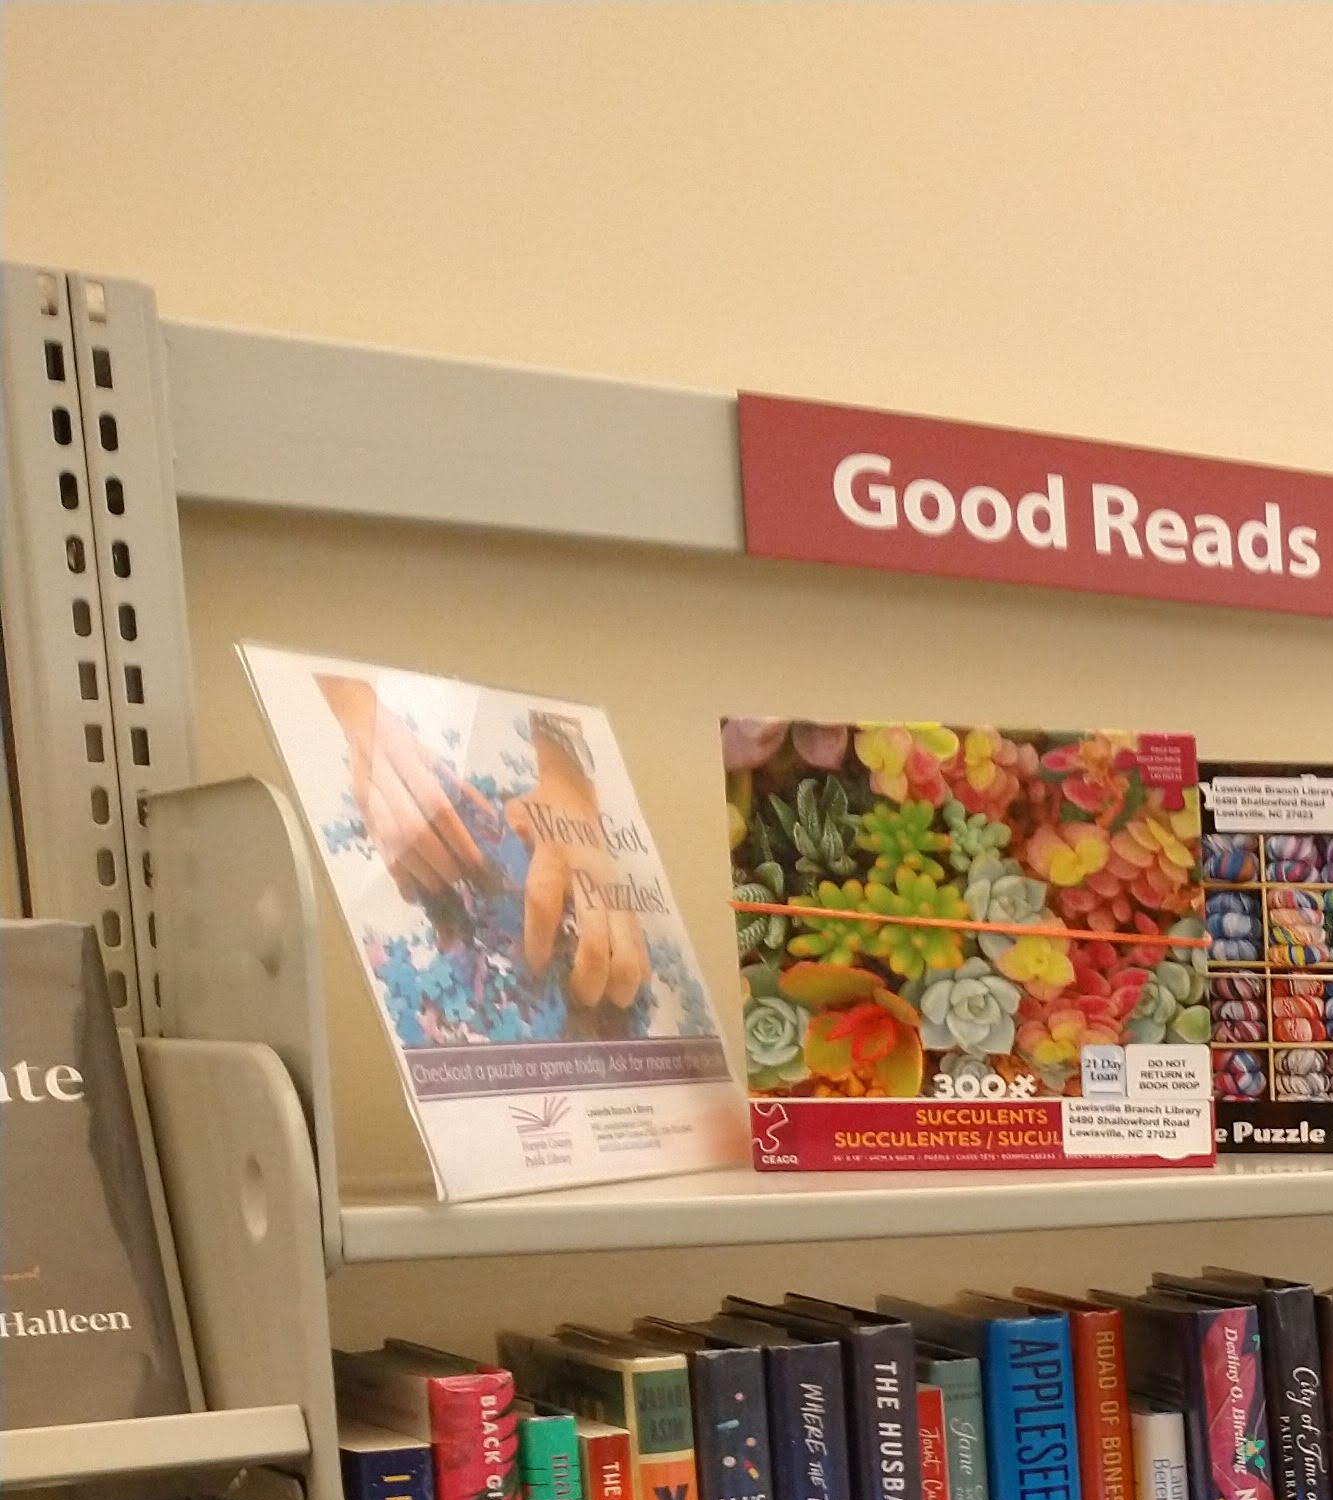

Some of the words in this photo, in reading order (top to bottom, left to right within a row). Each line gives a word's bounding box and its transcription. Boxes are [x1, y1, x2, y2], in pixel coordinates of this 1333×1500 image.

[833, 452, 1067, 550] Good
[1091, 482, 1321, 578] Reads
[523, 801, 598, 848] We've
[598, 811, 649, 858] Got
[573, 872, 670, 916] Puzzles!
[1090, 1070, 1119, 1083] Loan
[1101, 1059, 1122, 1073] Day
[1141, 1070, 1181, 1079] RETURN
[1185, 1070, 1195, 1078] IN
[1148, 1059, 1162, 1069] DO
[1165, 1059, 1186, 1068] NOT
[933, 1073, 1007, 1099] 300
[1139, 1081, 1169, 1090] BOOK
[1173, 1081, 1200, 1089] DROP
[915, 1108, 1049, 1126] SUCCULENTS
[1068, 1103, 1120, 1115] Lewisville
[1123, 1104, 1162, 1116] Branch
[1166, 1105, 1202, 1119] Library
[835, 1131, 981, 1149] SUCCULENTES
[999, 1130, 1063, 1146] SUCUL
[1233, 1122, 1326, 1144] Puzzle
[0, 1308, 132, 1338] Halleen
[1095, 1330, 1117, 1391] ROAD
[873, 1361, 899, 1410] THE
[799, 1382, 828, 1456] WHERE
[1100, 1401, 1119, 1426] OF
[480, 1395, 501, 1464] BLACK
[601, 1462, 622, 1497] THE
[807, 1460, 827, 1488] THE
